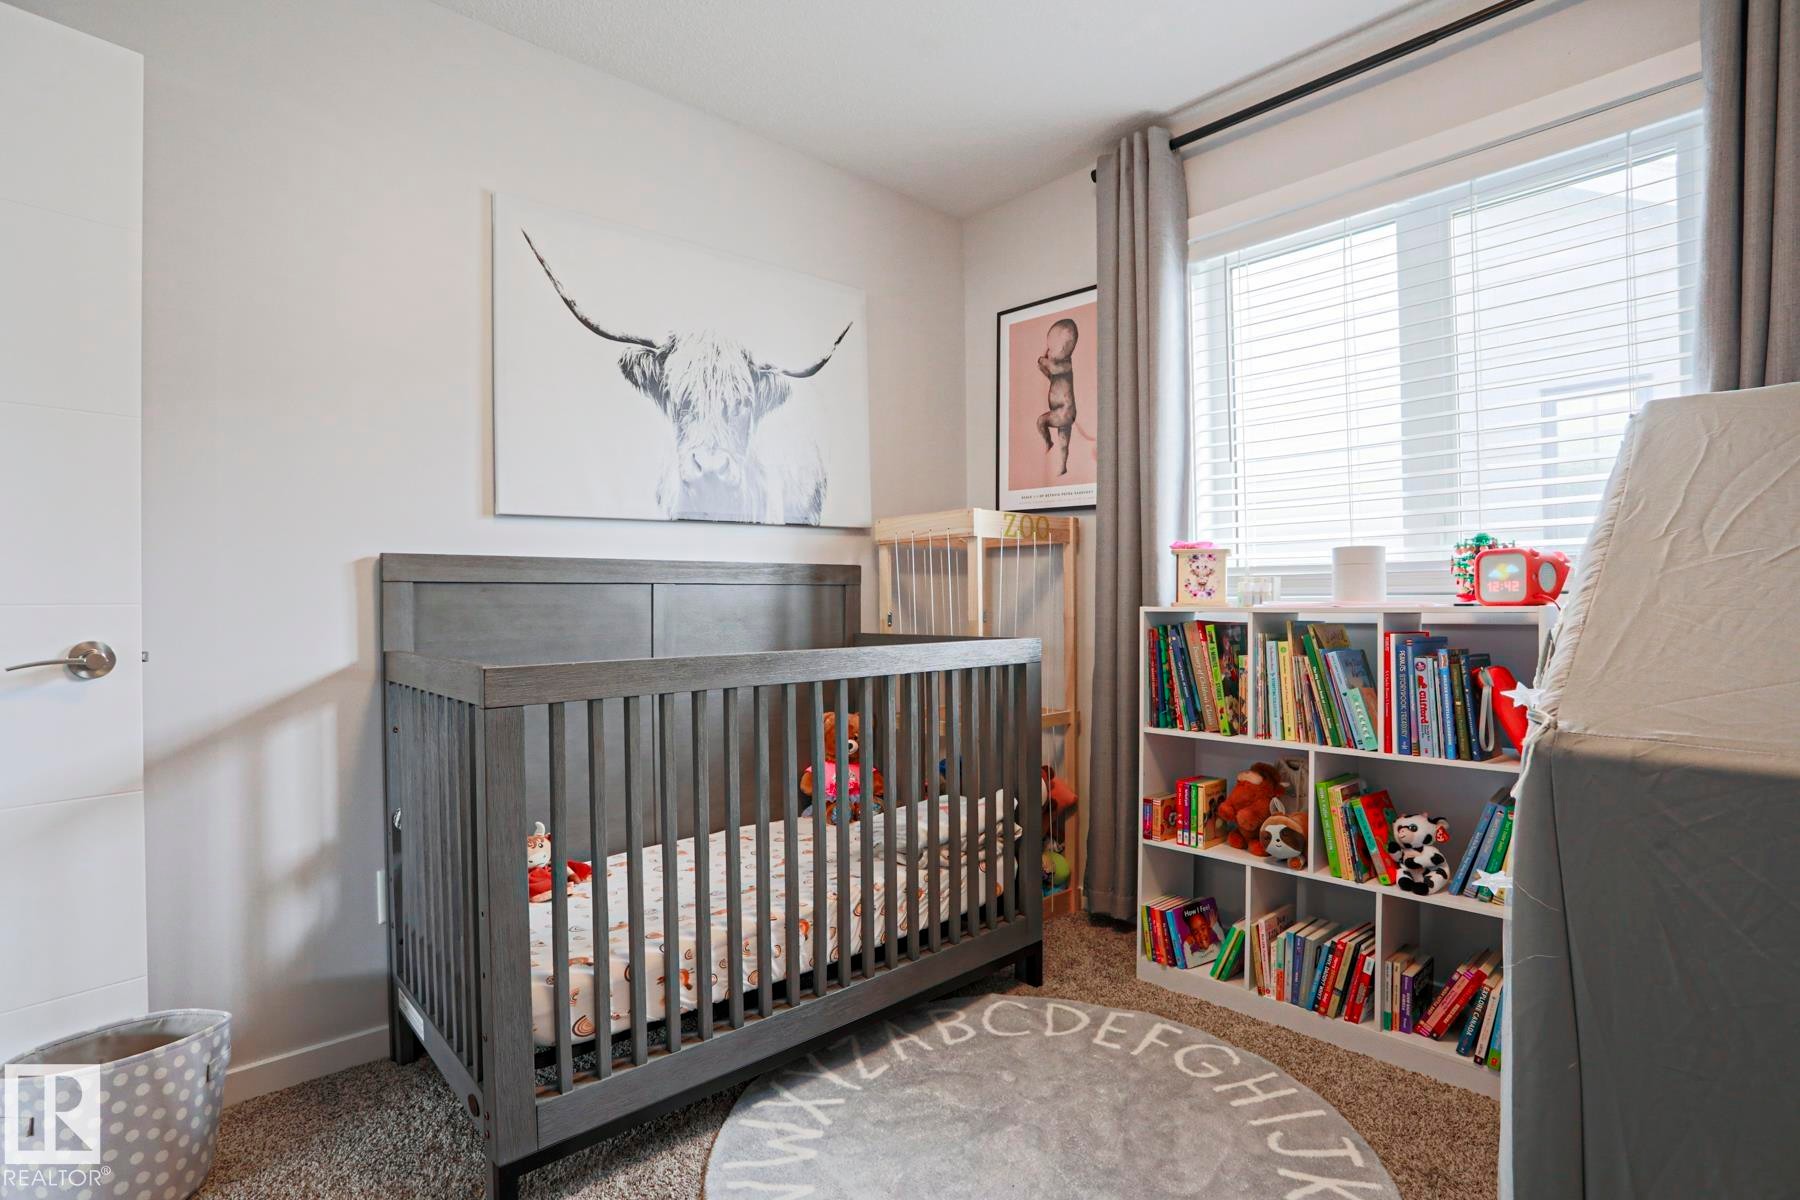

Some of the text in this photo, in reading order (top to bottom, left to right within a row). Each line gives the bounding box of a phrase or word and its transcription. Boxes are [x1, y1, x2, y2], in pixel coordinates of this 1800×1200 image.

[1004, 513, 1049, 539] ZOO
[1487, 581, 1520, 592] 12:42
[1419, 690, 1428, 724] Clifford
[1200, 904, 1210, 912] Feel
[1316, 985, 1324, 1000] WHY?
[1319, 965, 1329, 986] DADDY?
[1475, 986, 1490, 1012] EXPLORE
[929, 1010, 976, 1045] B
[982, 1000, 1031, 1036] C
[1044, 1003, 1090, 1037] D
[1093, 1011, 1135, 1049] E
[1466, 1010, 1480, 1036] CANADA
[886, 1020, 933, 1061] A
[1131, 1022, 1183, 1055] F
[783, 1053, 862, 1090] Y
[828, 1035, 890, 1079] Z
[1174, 1044, 1240, 1077] G
[752, 1080, 845, 1125] X
[1213, 1072, 1298, 1107] H
[721, 1119, 824, 1169] W
[1267, 1131, 1364, 1167] J
[1277, 1168, 1383, 1200] K
